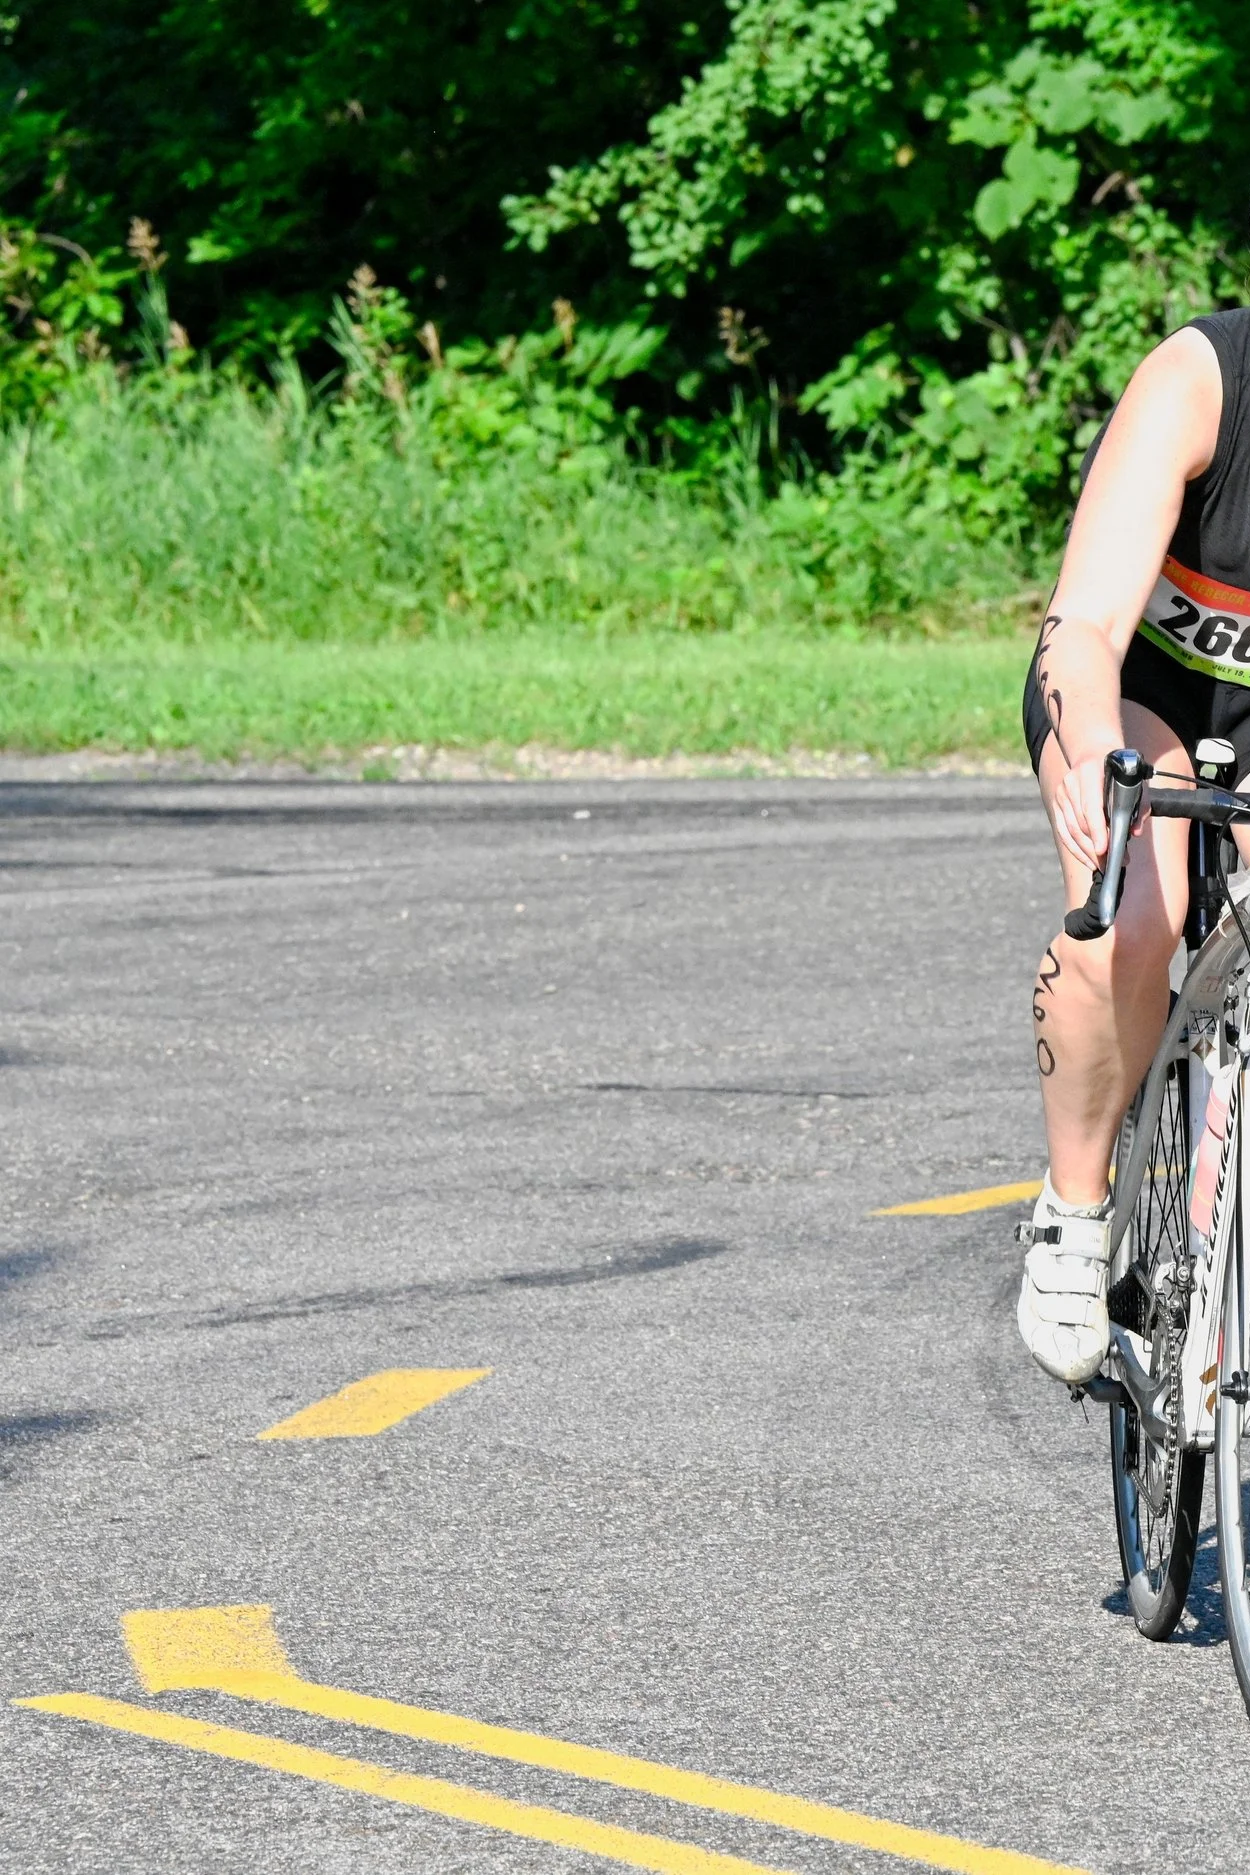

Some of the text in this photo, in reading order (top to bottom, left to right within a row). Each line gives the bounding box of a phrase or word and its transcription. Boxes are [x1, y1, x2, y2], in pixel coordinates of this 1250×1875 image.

[1190, 580, 1245, 605] REBECCA
[1212, 664, 1231, 675] JULY
[1032, 947, 1061, 1077] 260
